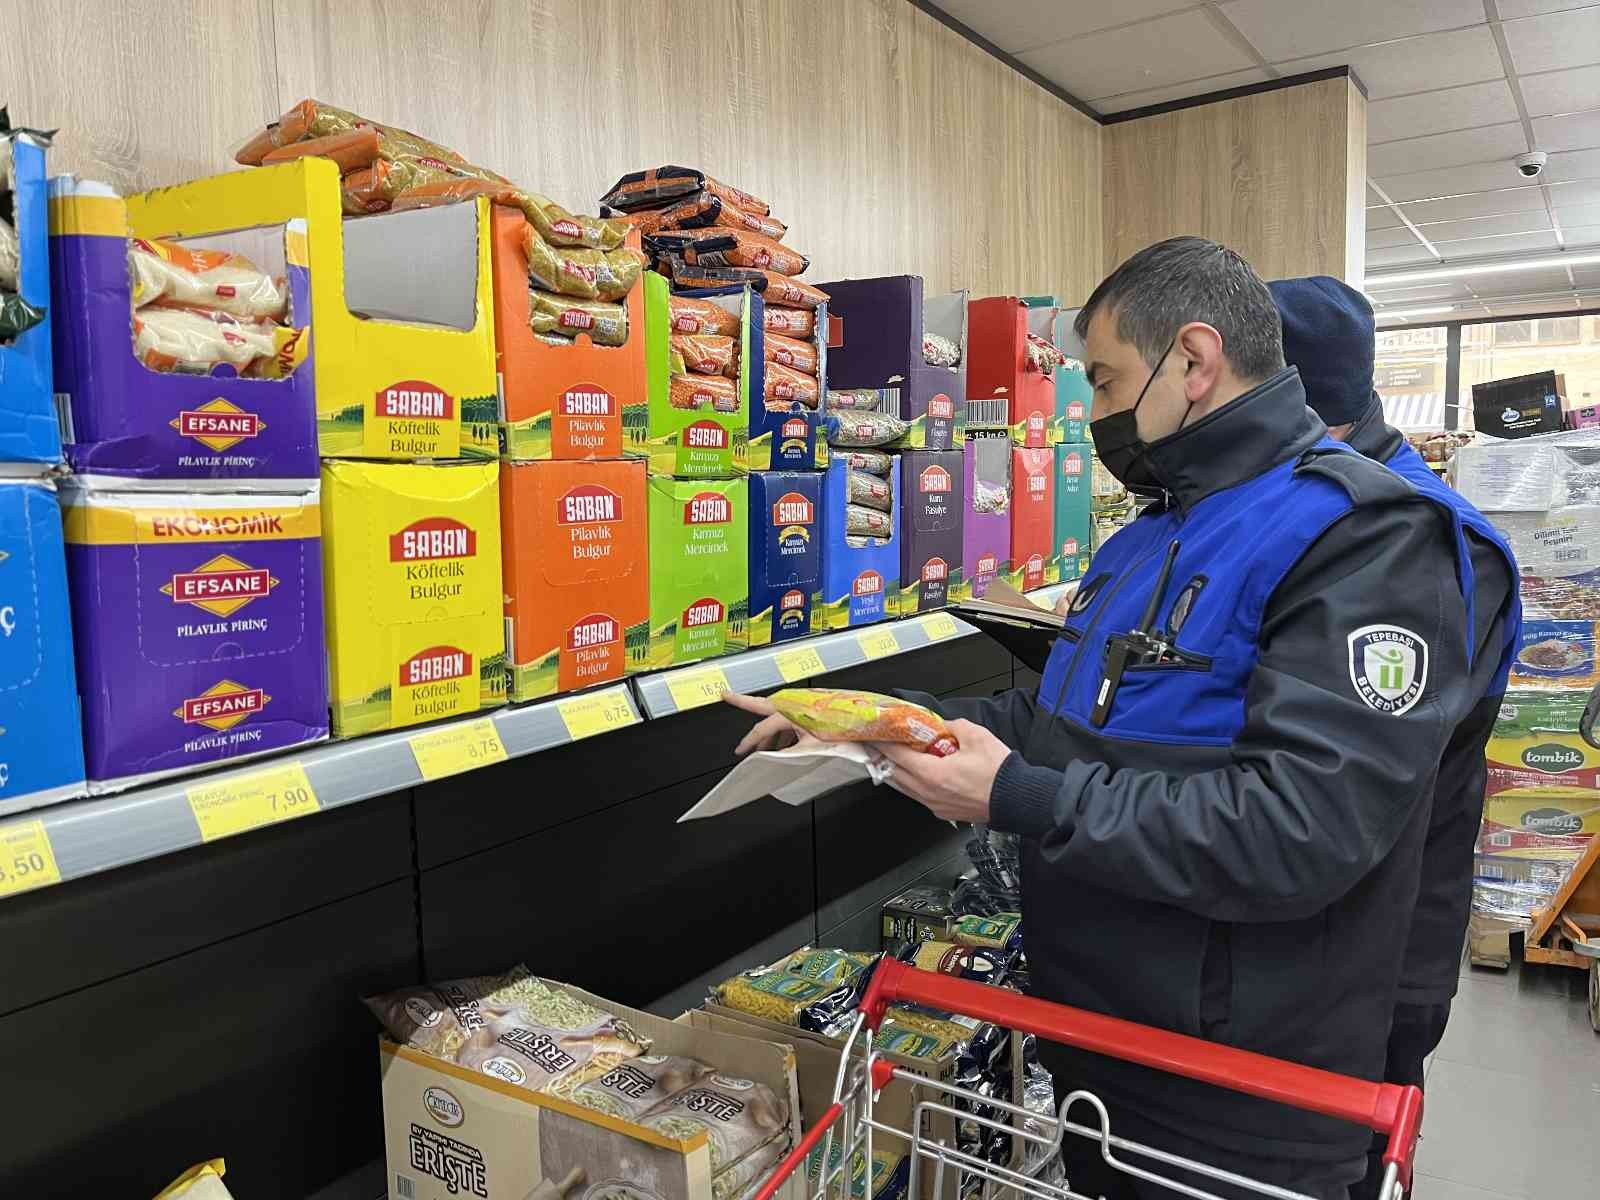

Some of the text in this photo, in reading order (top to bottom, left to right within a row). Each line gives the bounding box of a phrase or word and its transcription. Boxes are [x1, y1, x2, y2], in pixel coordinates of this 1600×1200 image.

[565, 312, 591, 328] SABAN
[387, 390, 444, 417] SABAN
[566, 391, 609, 415] SABAN
[186, 416, 253, 434] EFSANE
[388, 420, 440, 437] Köftelik
[391, 438, 438, 455] Bulgur
[570, 433, 605, 448] Bulgur
[689, 427, 723, 447] SABAN
[178, 456, 256, 469] PİLAVLIK PİRİNÇ
[924, 473, 947, 491] SABAN
[566, 495, 614, 522] SABAN
[691, 499, 727, 523] SABAN
[779, 503, 808, 523] SABAN
[153, 512, 283, 537] EKONOMİK
[403, 528, 467, 559] SABAN
[571, 527, 612, 542] Pilavlık
[572, 543, 612, 560] Bulgur
[685, 541, 729, 556] Mercimek
[406, 562, 465, 580] Köftelik
[926, 564, 944, 580] SABAN
[184, 576, 261, 596] EFSANE
[409, 584, 463, 600] Bulgur
[857, 576, 880, 594] SABAN
[784, 597, 801, 607] SABAN
[688, 604, 720, 626] SABAN
[177, 618, 268, 637] PİLAVLIK PİRİNÇ
[573, 621, 613, 647] SABAN
[409, 653, 464, 684] SABAN
[575, 661, 610, 678] Bulgur
[411, 681, 462, 701] Köftelik
[193, 696, 256, 717] EFSANE
[414, 698, 459, 717] Bulgur
[604, 704, 631, 723] 8,75
[184, 729, 263, 752] PİLAVLIK PİRİNÇ
[467, 739, 499, 759] 8,75
[1526, 750, 1582, 764] tombik
[266, 787, 309, 812] 7,90
[1525, 815, 1582, 829] tombik
[502, 1027, 576, 1072] ERİŞTE
[410, 1135, 488, 1198] ERİŞTE
